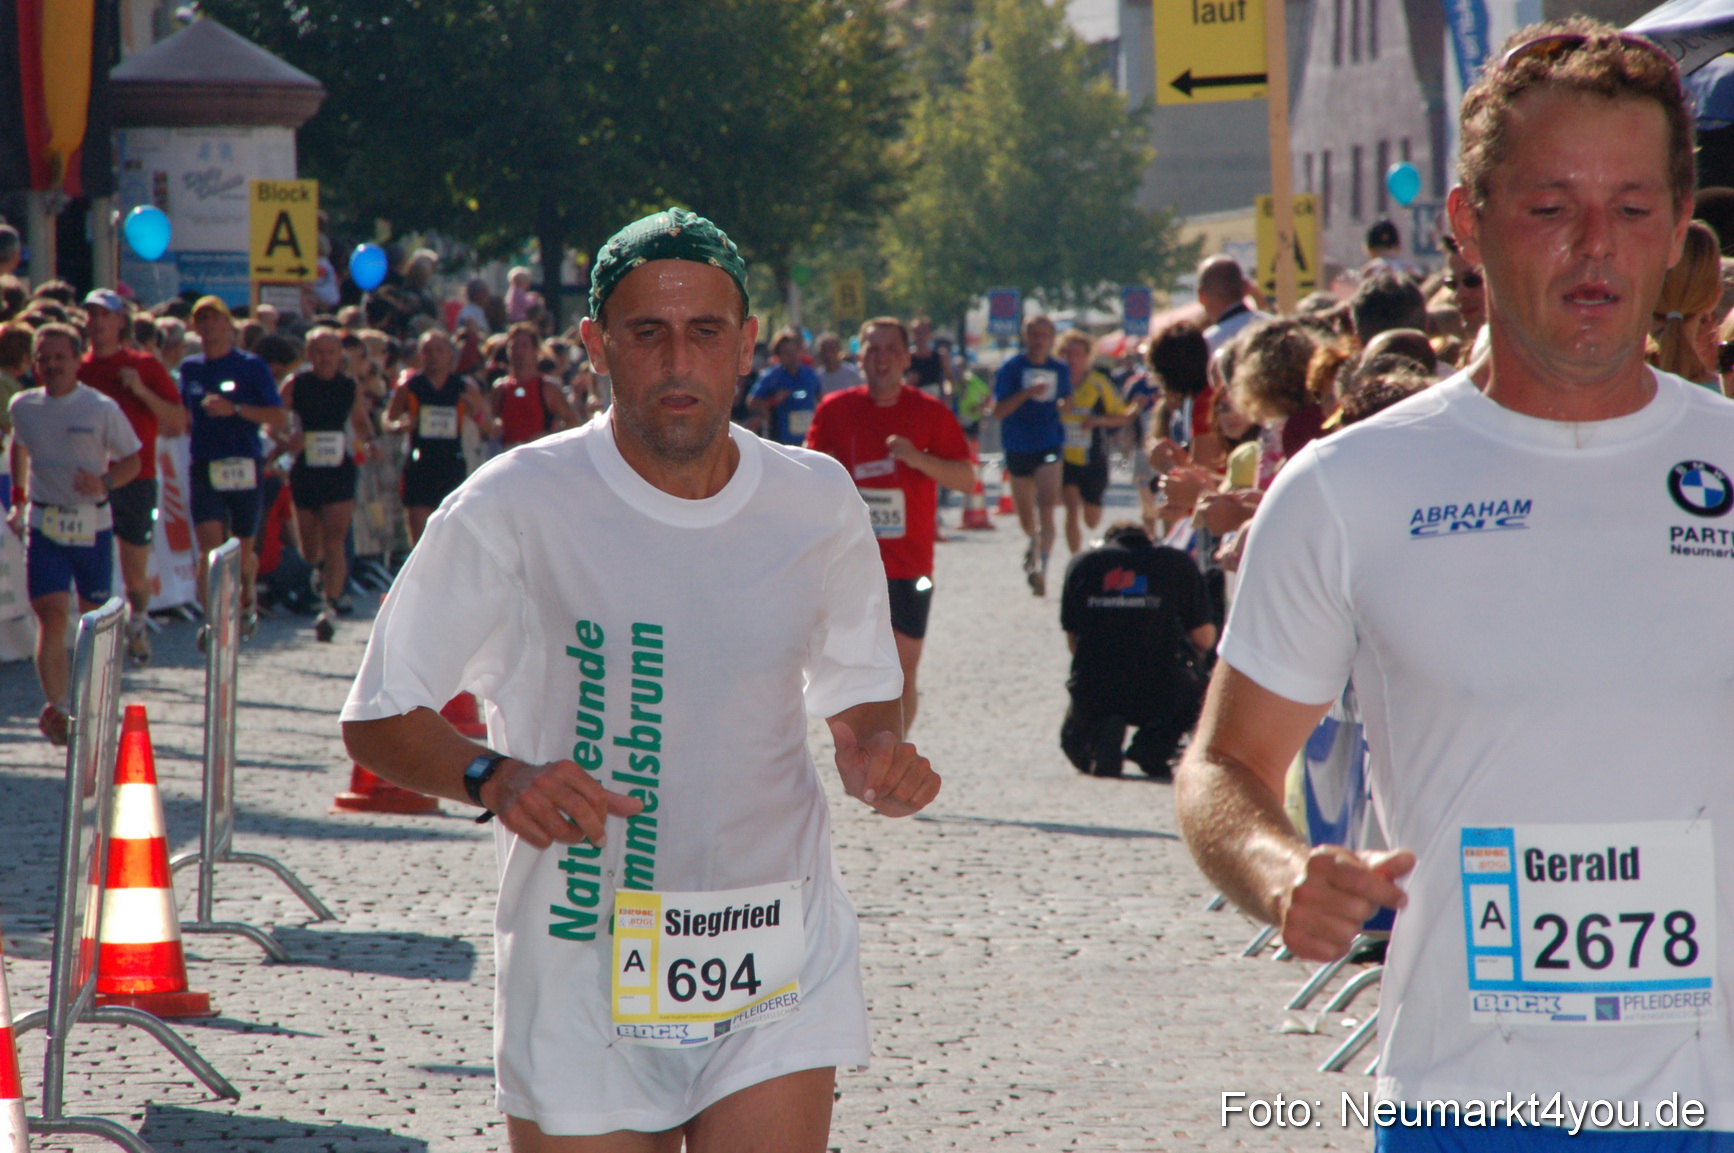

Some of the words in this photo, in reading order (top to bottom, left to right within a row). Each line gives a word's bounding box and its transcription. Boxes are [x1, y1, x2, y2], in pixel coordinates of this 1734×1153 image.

[1192, 0, 1248, 25] lauf
[256, 183, 309, 202] Block
[264, 209, 302, 258] A
[1410, 498, 1533, 526] ABRAHAM
[1410, 515, 1528, 536] CNC
[1523, 846, 1640, 883] Gerald
[664, 899, 781, 938] Siegfried
[1479, 899, 1507, 931] A
[1532, 909, 1700, 971] 2678
[622, 949, 646, 973] A
[666, 952, 762, 1003] 694
[732, 991, 800, 1025] PFLEIDERER
[1473, 994, 1563, 1015] BOCK
[1623, 991, 1713, 1011] PFLEIDERER
[616, 1023, 689, 1041] BOCK
